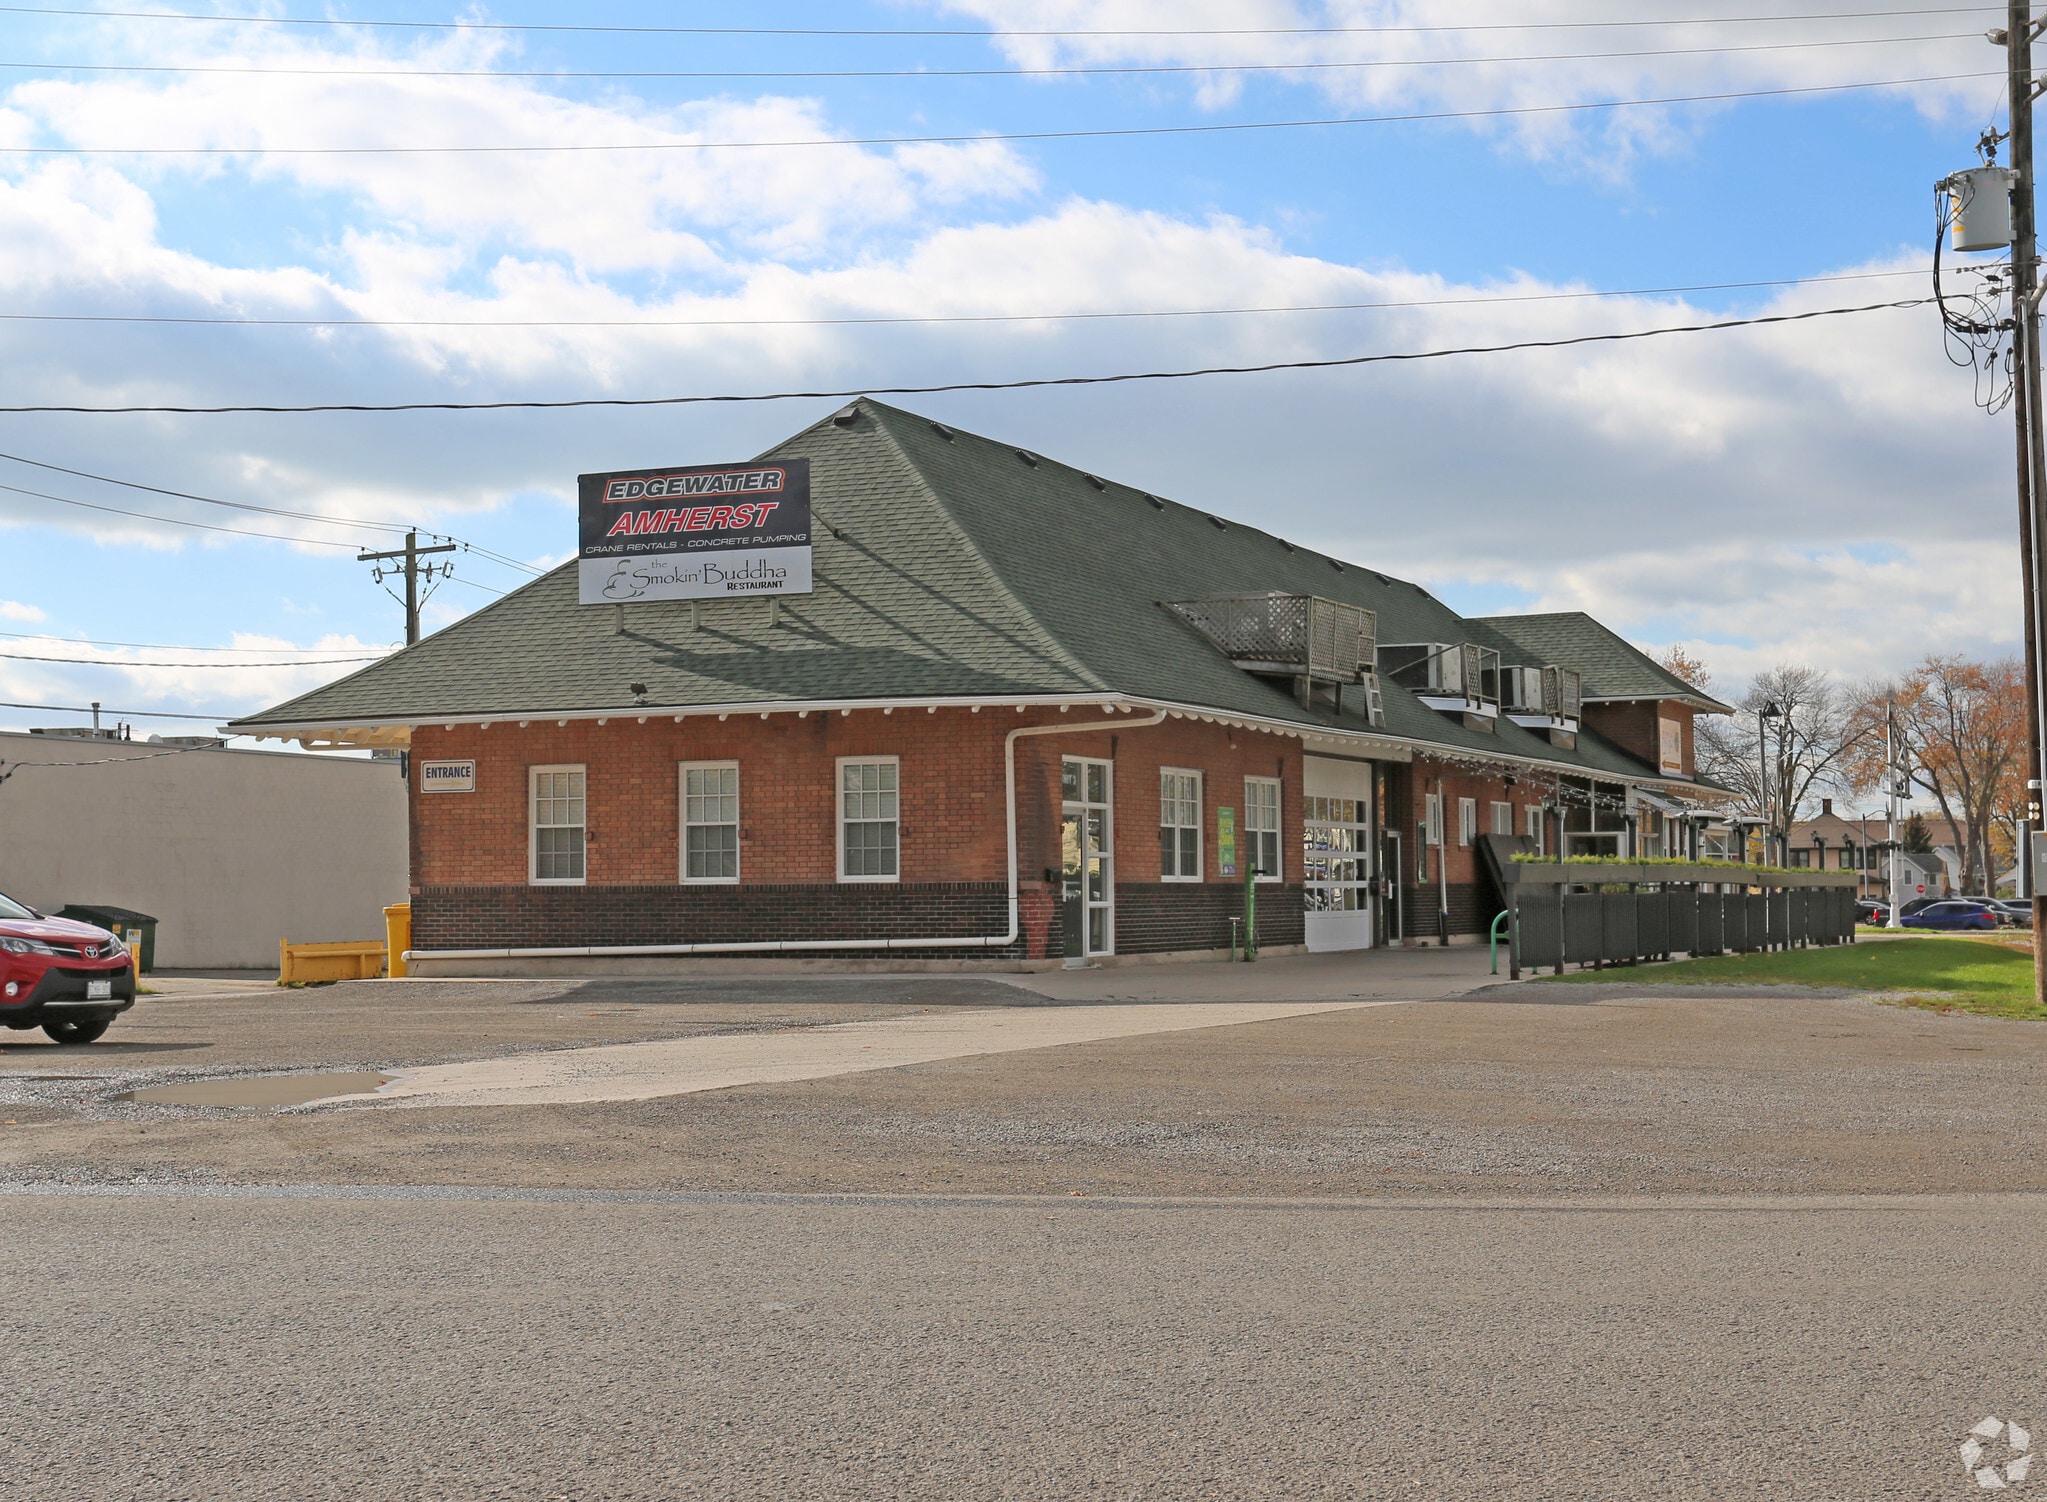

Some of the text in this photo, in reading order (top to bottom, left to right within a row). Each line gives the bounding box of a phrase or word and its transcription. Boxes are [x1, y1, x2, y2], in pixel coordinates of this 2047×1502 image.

[606, 471, 782, 500] EDGEWATER
[606, 502, 779, 536] AMHERST
[585, 545, 624, 554] CRANE
[626, 541, 677, 551] RENTALS
[687, 537, 749, 548] CONCRETE
[752, 533, 807, 544] PUMPING
[629, 559, 787, 589] Smokin' Buddha
[651, 559, 668, 569] the
[727, 580, 784, 591] RESTAURANT
[426, 766, 471, 779] ENTRANCE
